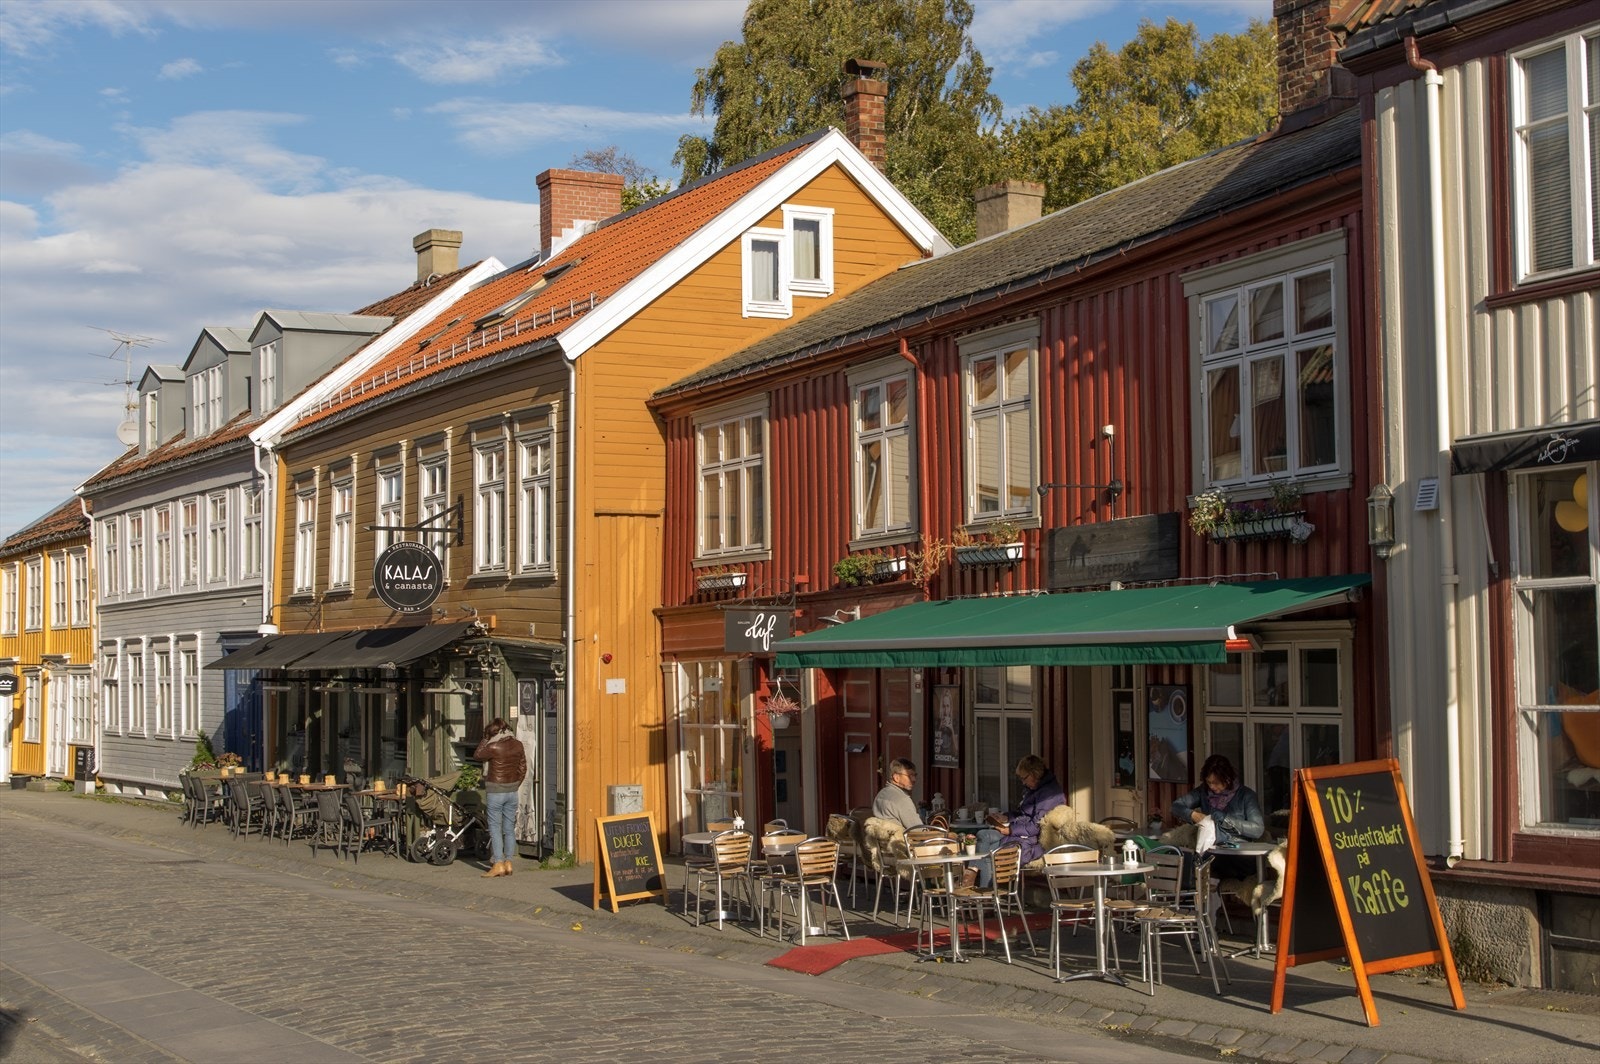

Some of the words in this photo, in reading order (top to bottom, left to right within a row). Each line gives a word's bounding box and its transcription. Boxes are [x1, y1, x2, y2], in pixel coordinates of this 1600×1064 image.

[392, 542, 426, 551] RESTAURANT
[385, 565, 433, 580] KALAS
[394, 582, 433, 590] canasta
[612, 832, 643, 849] DUGER
[1334, 823, 1405, 850] Studentrabatt
[1356, 847, 1371, 870] på
[1348, 868, 1410, 917] Kaffe
